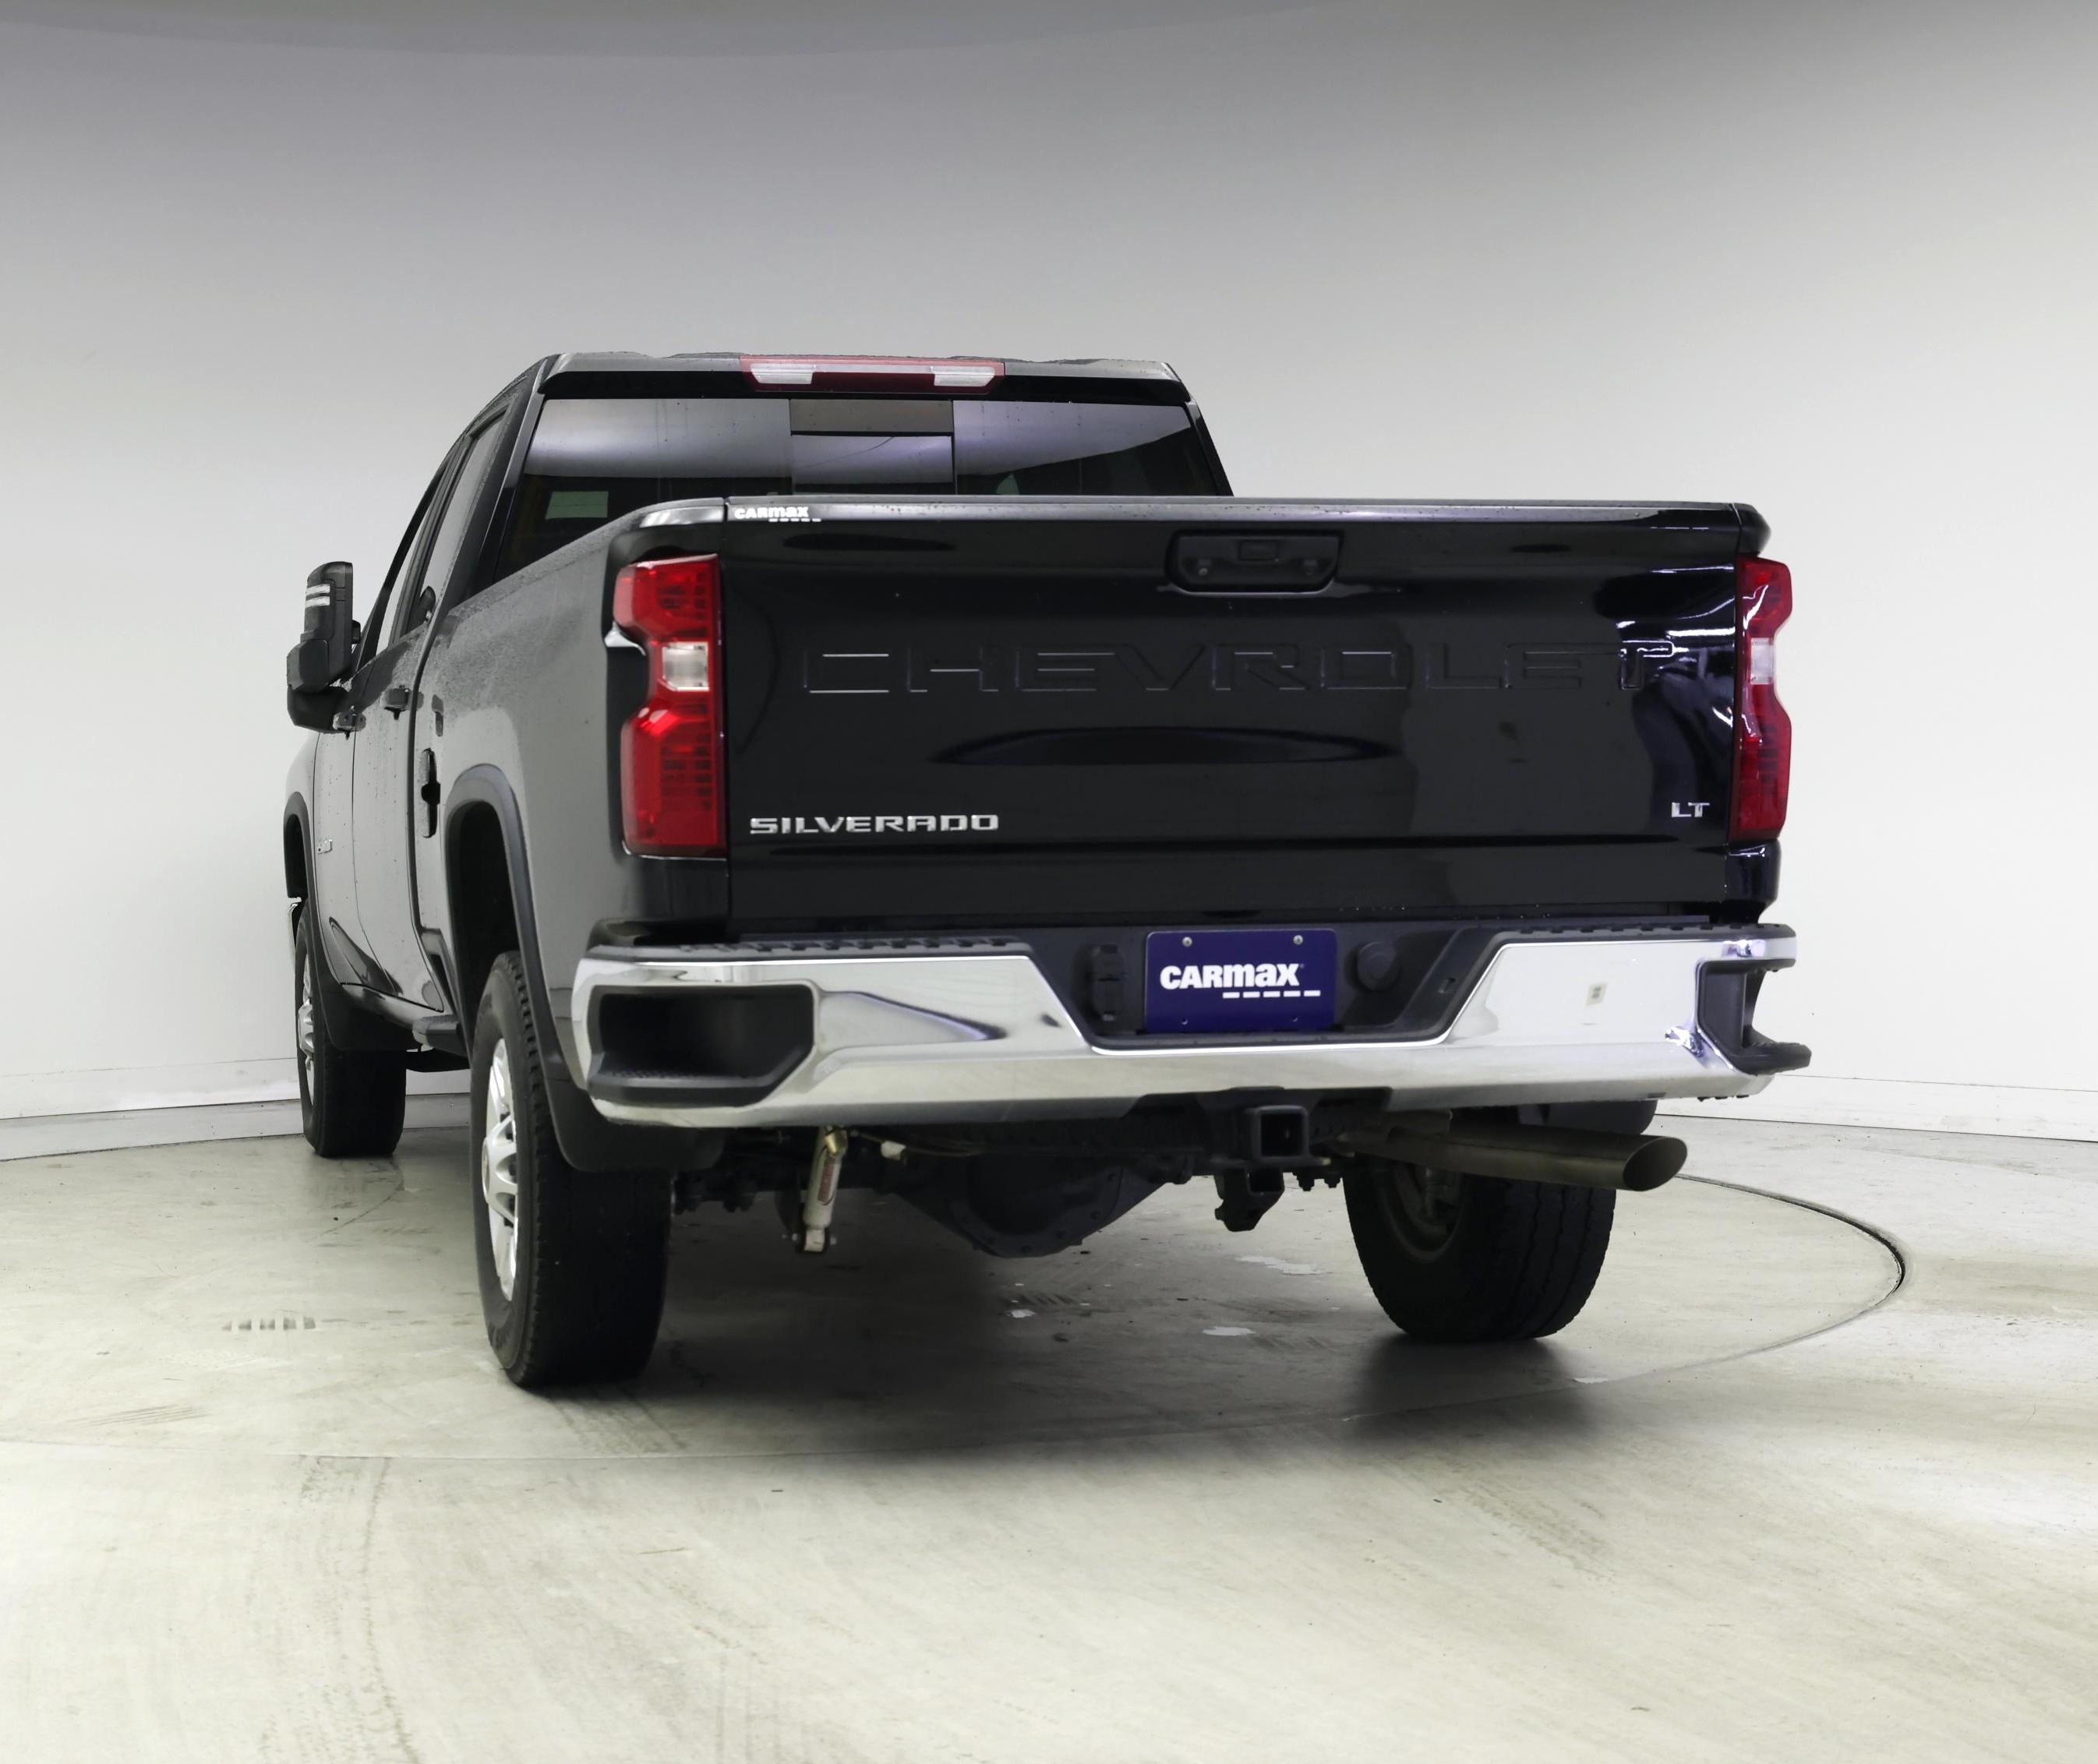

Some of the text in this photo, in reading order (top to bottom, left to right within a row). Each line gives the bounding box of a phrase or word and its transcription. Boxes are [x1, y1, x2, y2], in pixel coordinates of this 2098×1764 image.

[803, 640, 1675, 692] CHEVROLET
[1671, 802, 1710, 817] LT
[750, 814, 999, 834] SILVERADO
